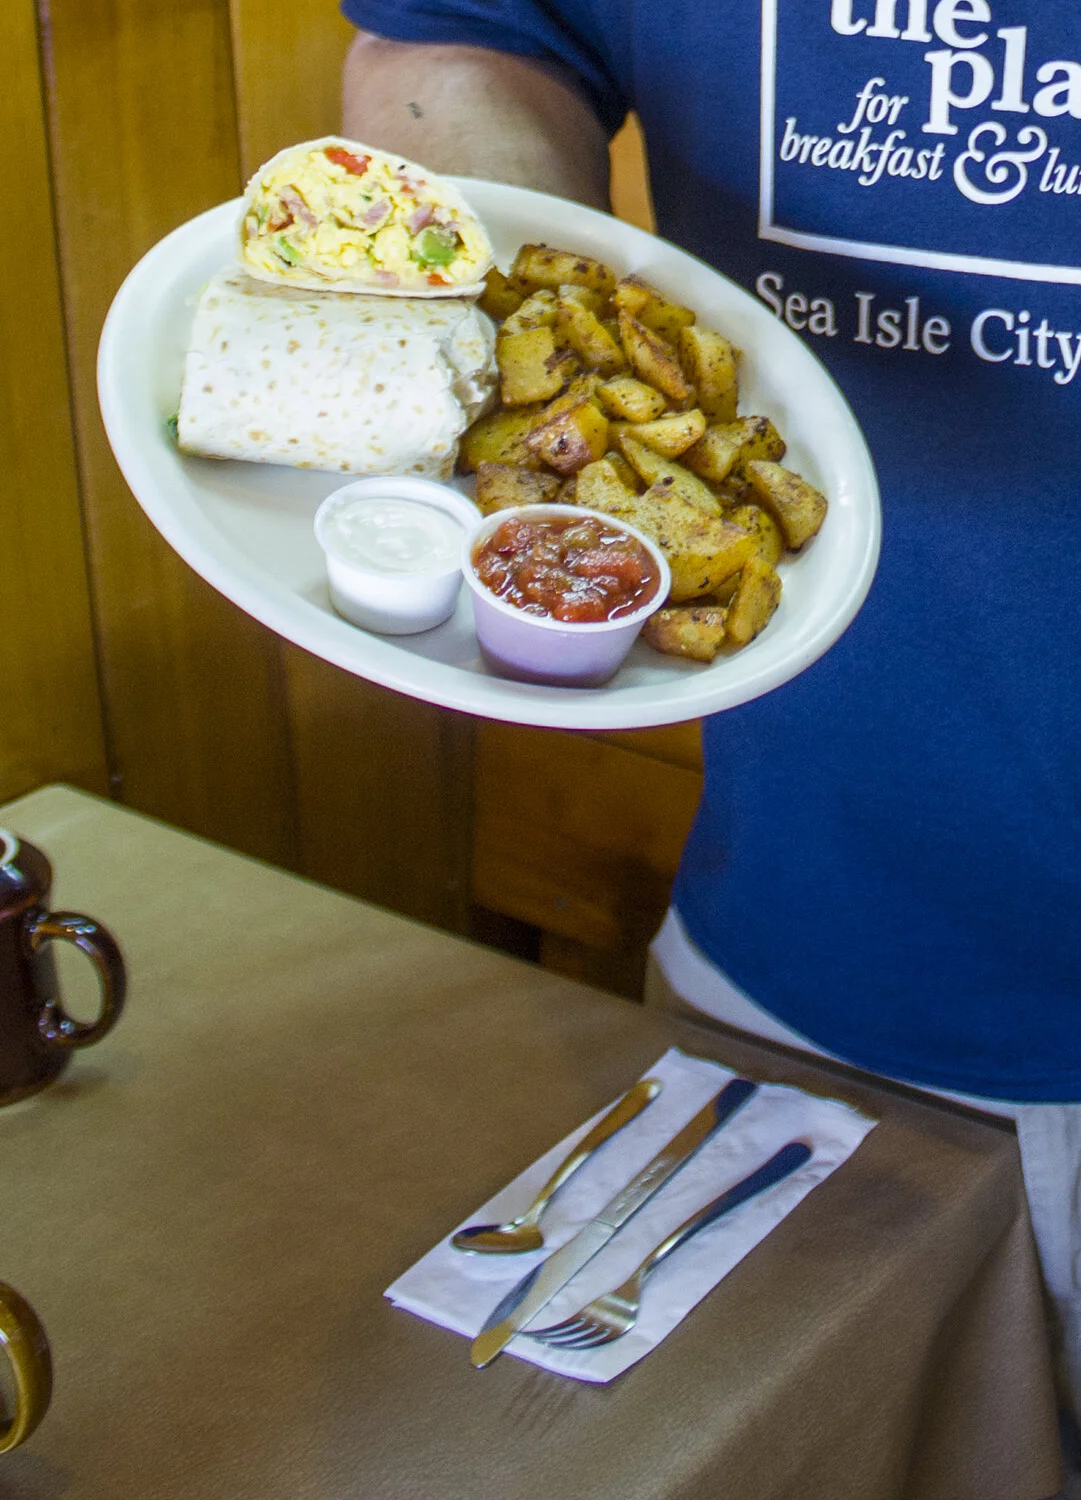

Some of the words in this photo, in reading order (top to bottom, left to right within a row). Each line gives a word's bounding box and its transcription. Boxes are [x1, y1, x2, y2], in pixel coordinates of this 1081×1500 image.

[838, 77, 908, 134] for
[779, 117, 946, 187] breakfast
[953, 121, 1048, 205] &
[756, 271, 838, 337] Sea
[853, 291, 951, 355] Isle
